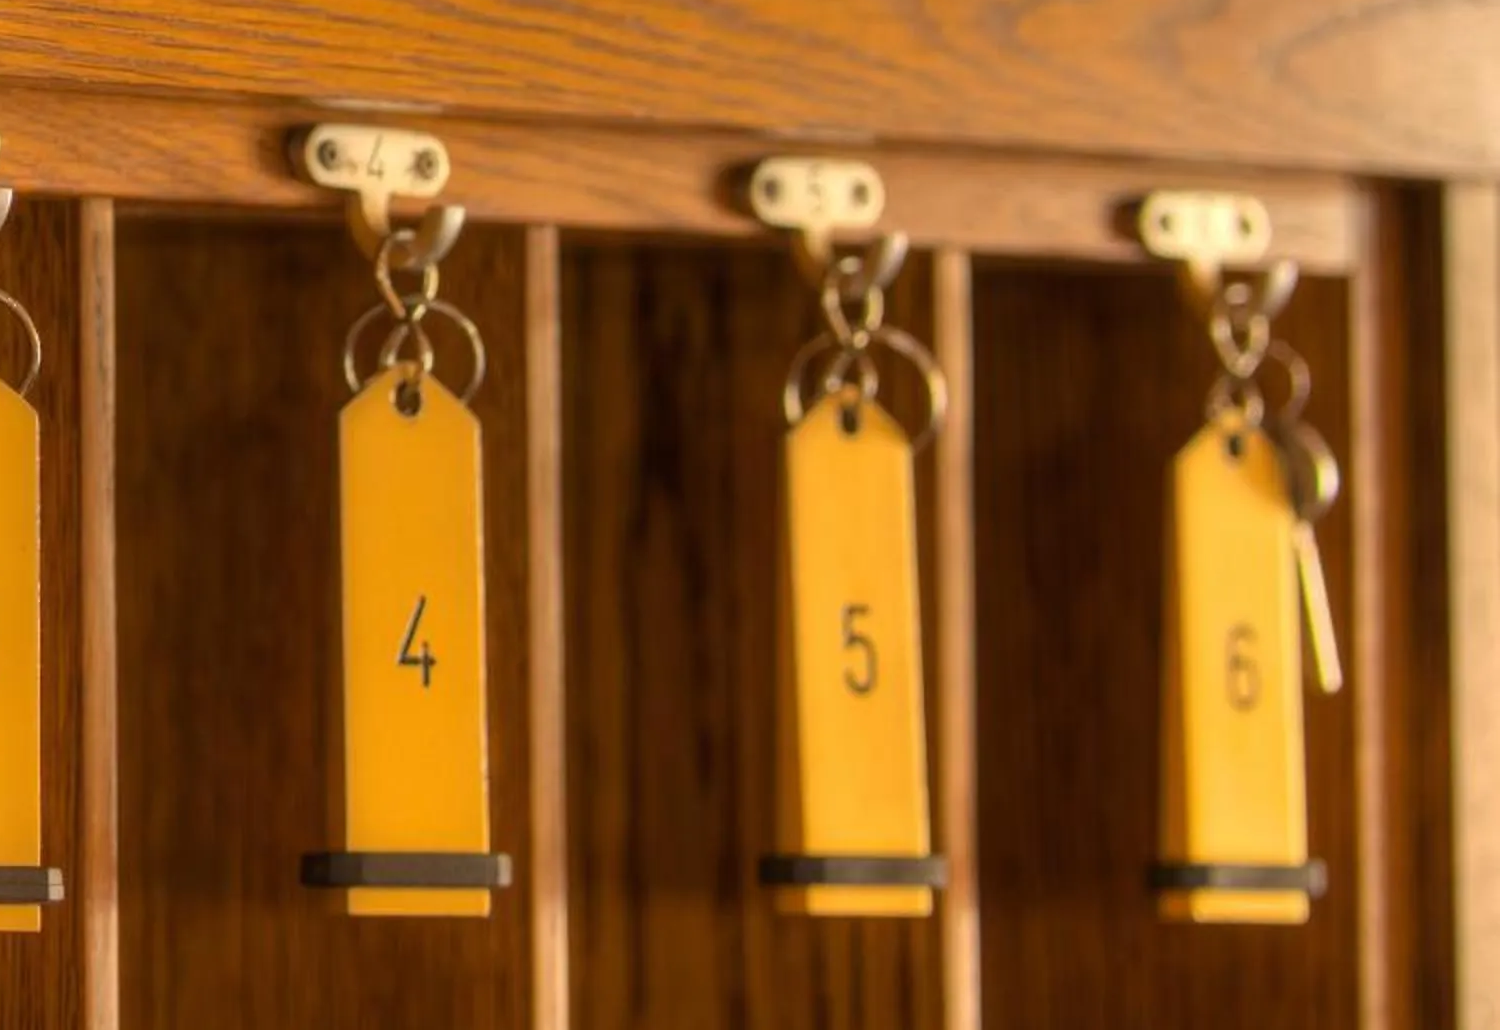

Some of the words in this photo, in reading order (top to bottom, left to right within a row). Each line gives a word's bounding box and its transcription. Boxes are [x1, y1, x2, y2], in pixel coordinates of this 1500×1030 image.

[364, 134, 385, 181] 4
[397, 594, 437, 689] 4
[840, 603, 879, 697] 5
[1224, 622, 1263, 714] 6
